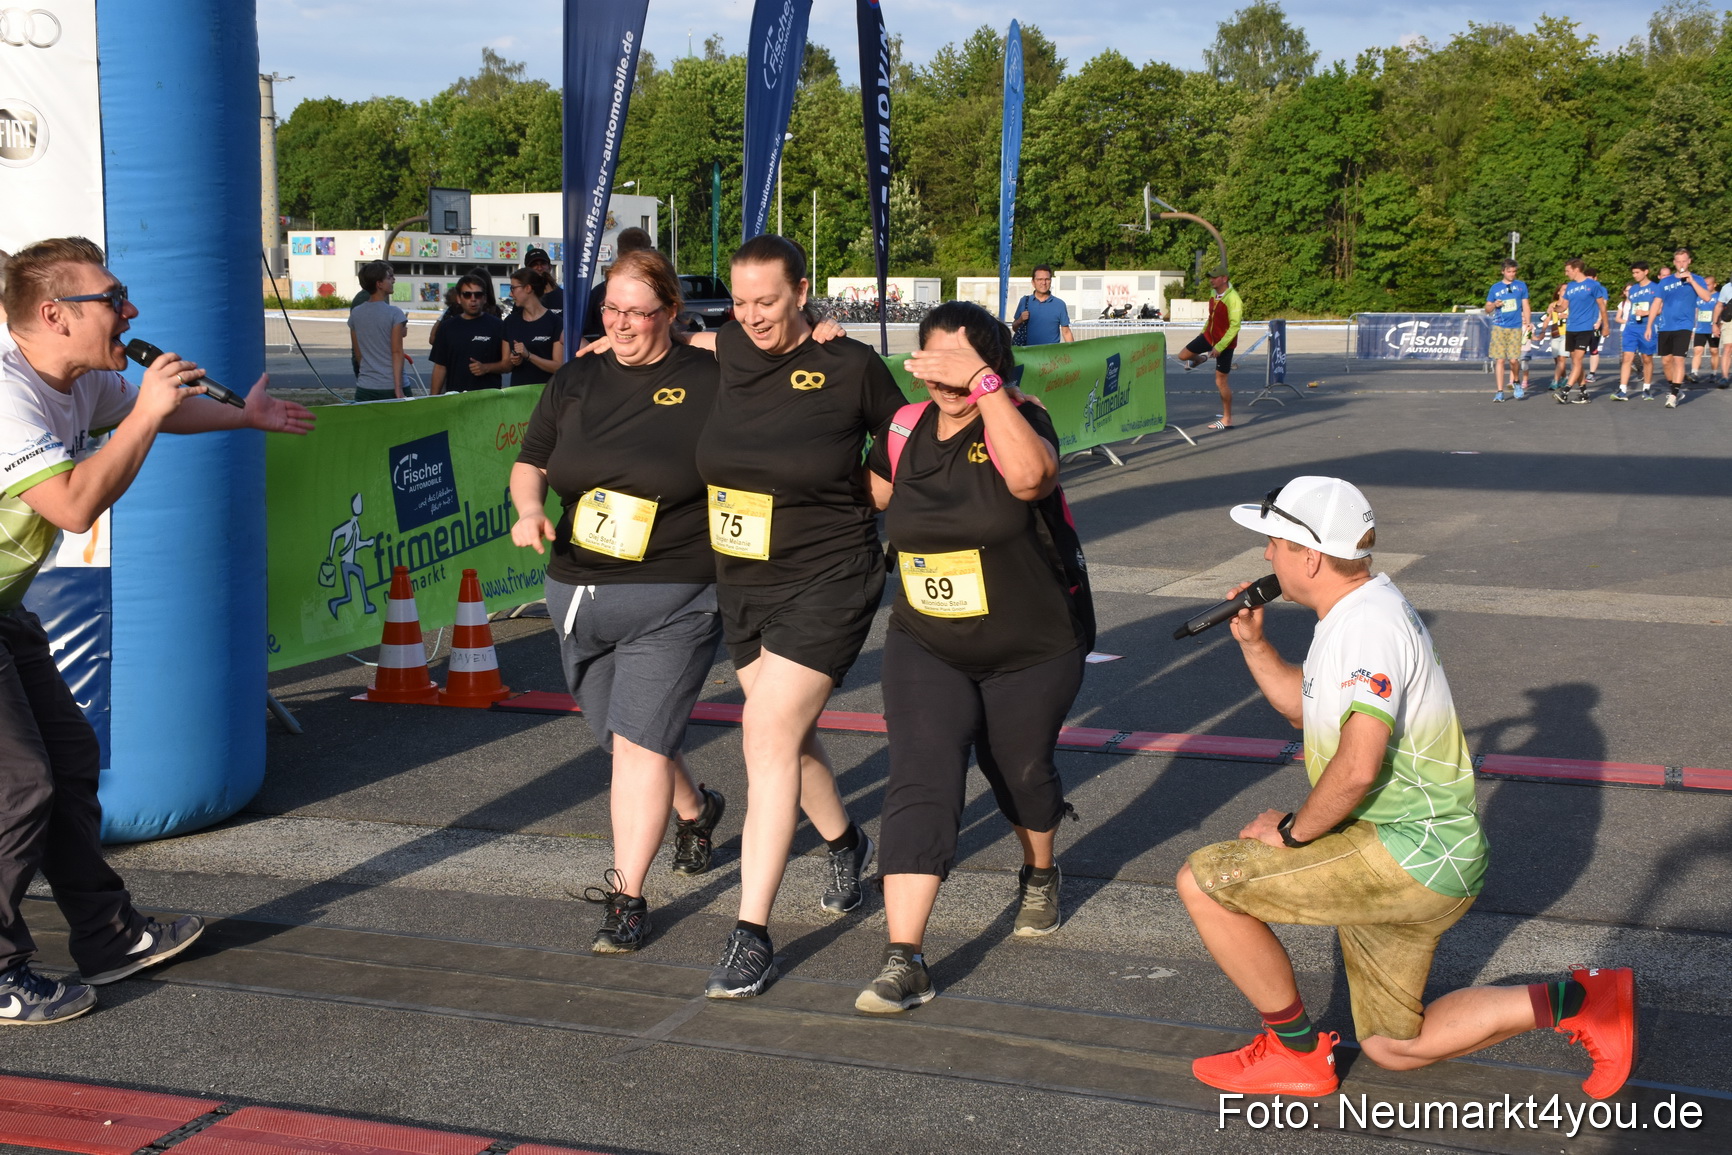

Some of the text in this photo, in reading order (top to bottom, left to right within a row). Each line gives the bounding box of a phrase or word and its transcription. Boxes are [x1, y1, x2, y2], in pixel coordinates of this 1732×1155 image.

[577, 31, 633, 278] www.fischer-automobile.de
[1400, 331, 1468, 346] Fischer
[403, 460, 443, 486] Fischer
[408, 476, 442, 493] AUTOMOBILE
[374, 485, 512, 584] firmenlauf
[721, 512, 742, 537] 75
[925, 577, 953, 600] 69
